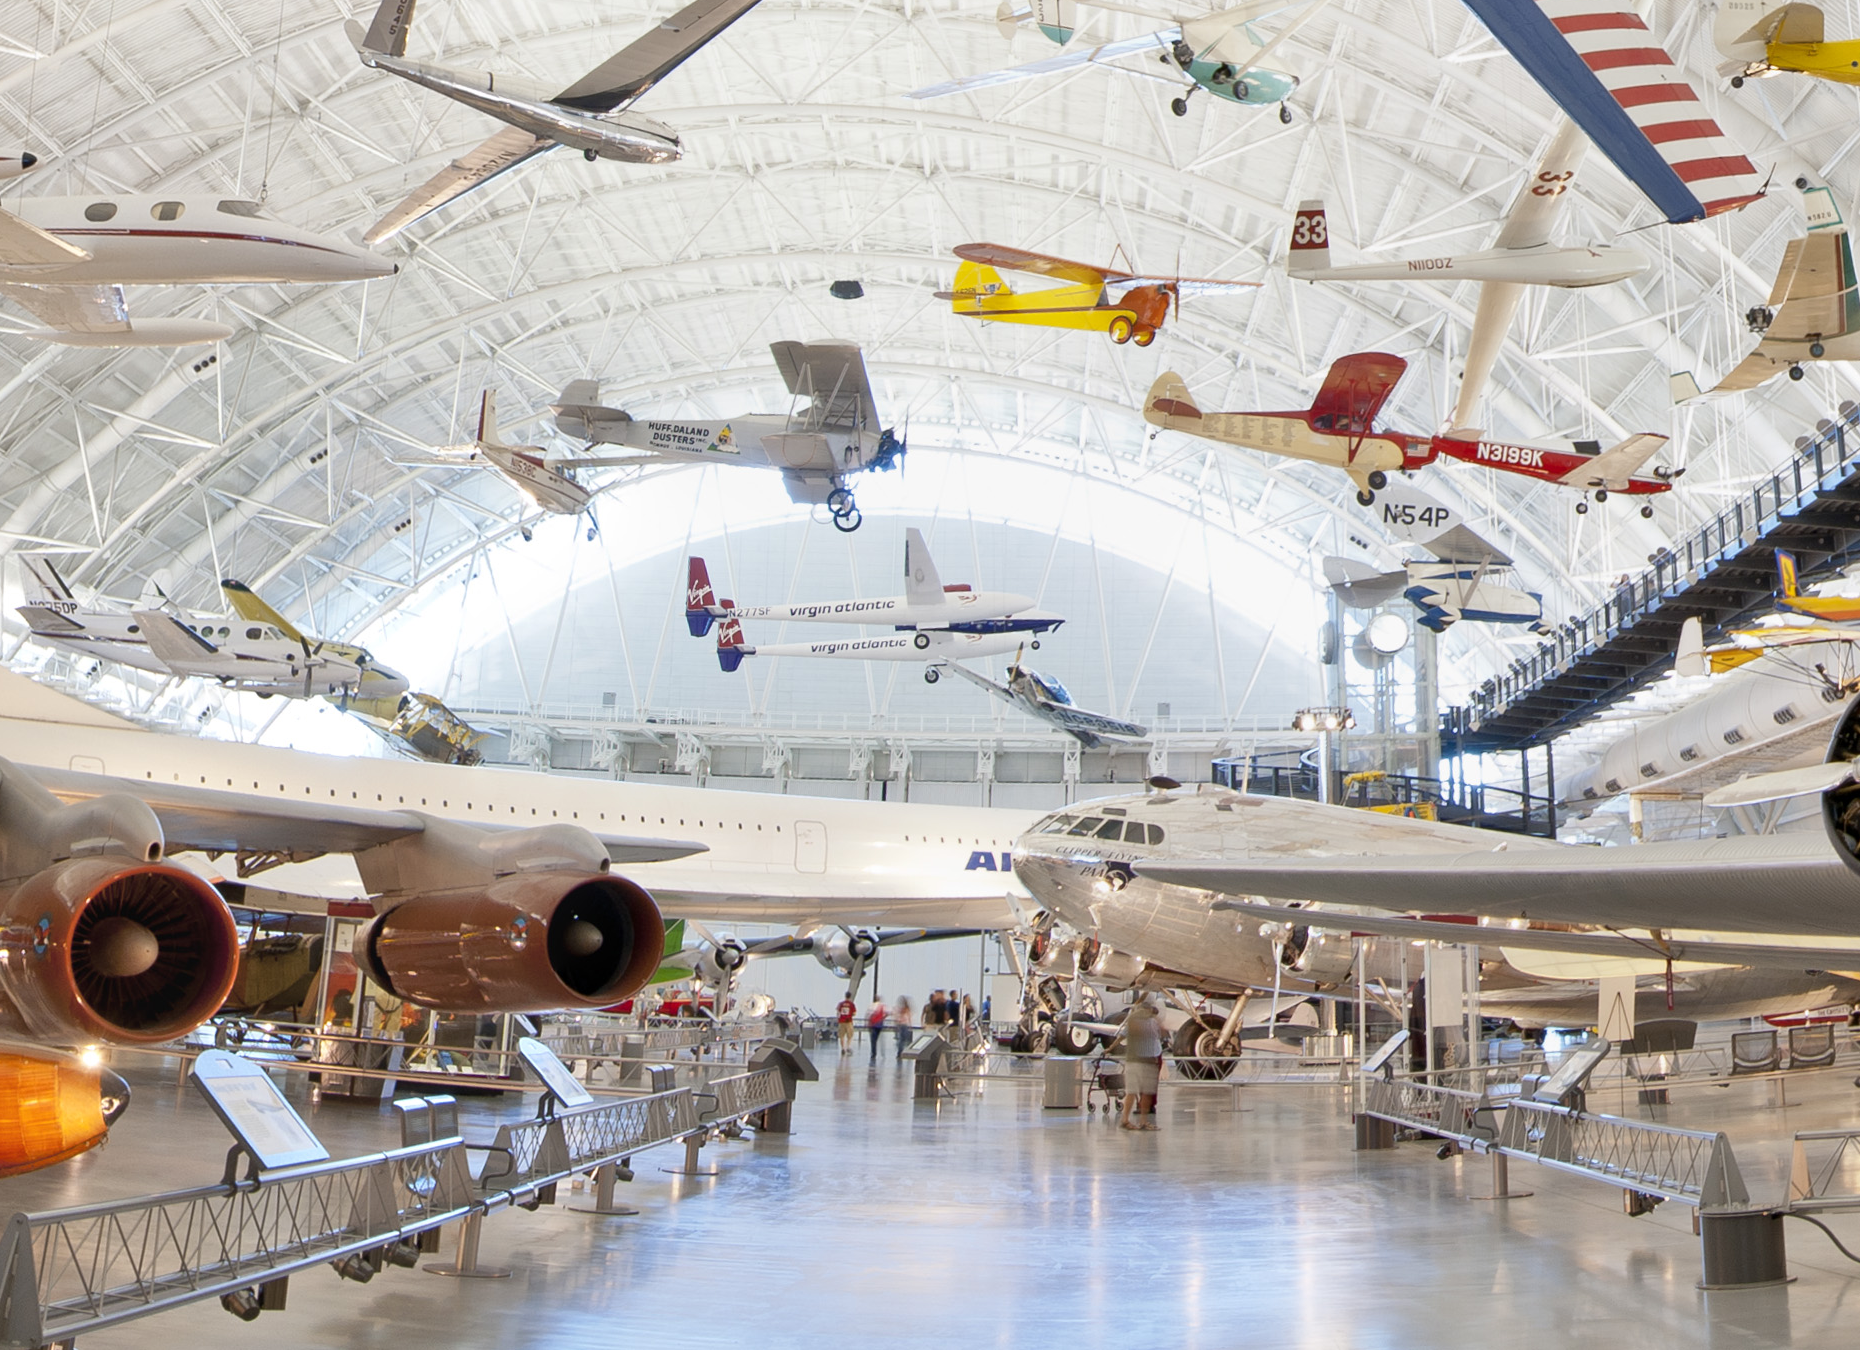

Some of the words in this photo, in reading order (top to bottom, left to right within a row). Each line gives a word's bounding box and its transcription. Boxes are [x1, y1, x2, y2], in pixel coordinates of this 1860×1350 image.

[1531, 170, 1574, 197] 33
[1294, 215, 1327, 245] 33
[1408, 258, 1454, 272] N1100Z
[652, 432, 695, 445] DUSTERS
[675, 445, 703, 453] LOUISIANA
[1477, 442, 1544, 468] N3199K
[1383, 503, 1450, 528] N54P
[687, 580, 713, 606] Virgin
[729, 607, 771, 618] N277SF
[790, 604, 832, 618] virgin
[834, 600, 895, 614] atlantic
[811, 641, 849, 654] virgin
[852, 637, 907, 651] atlantic
[1055, 845, 1101, 858] CLIPPER
[964, 851, 1012, 873] AI
